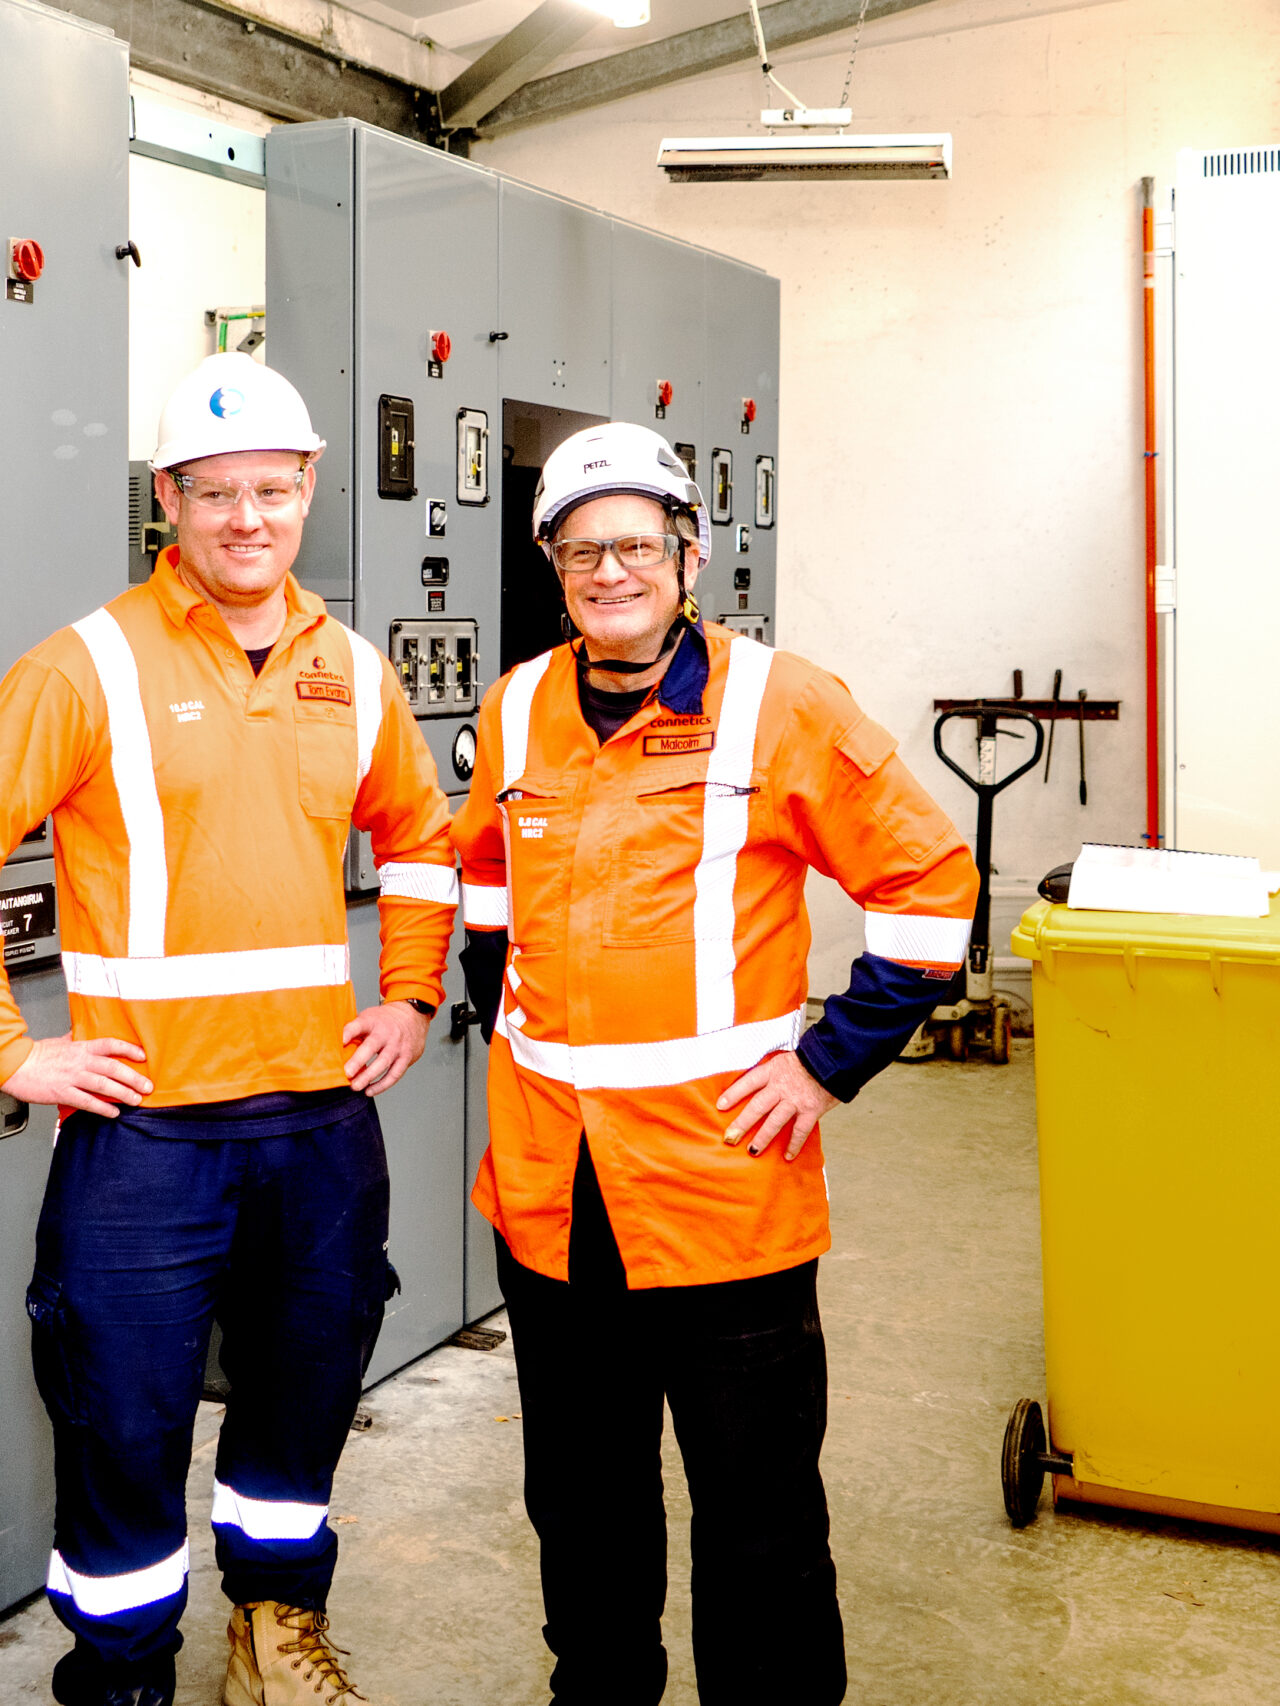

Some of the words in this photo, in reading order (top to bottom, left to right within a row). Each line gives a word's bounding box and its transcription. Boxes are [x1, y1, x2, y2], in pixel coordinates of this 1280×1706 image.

[583, 460, 612, 474] PETZL
[308, 684, 324, 696] Tom
[188, 700, 205, 711] CAL
[650, 716, 712, 728] connetics
[660, 738, 699, 751] Malcolm
[532, 817, 548, 827] CAL
[521, 828, 543, 838] HRC2
[23, 913, 32, 932] 7
